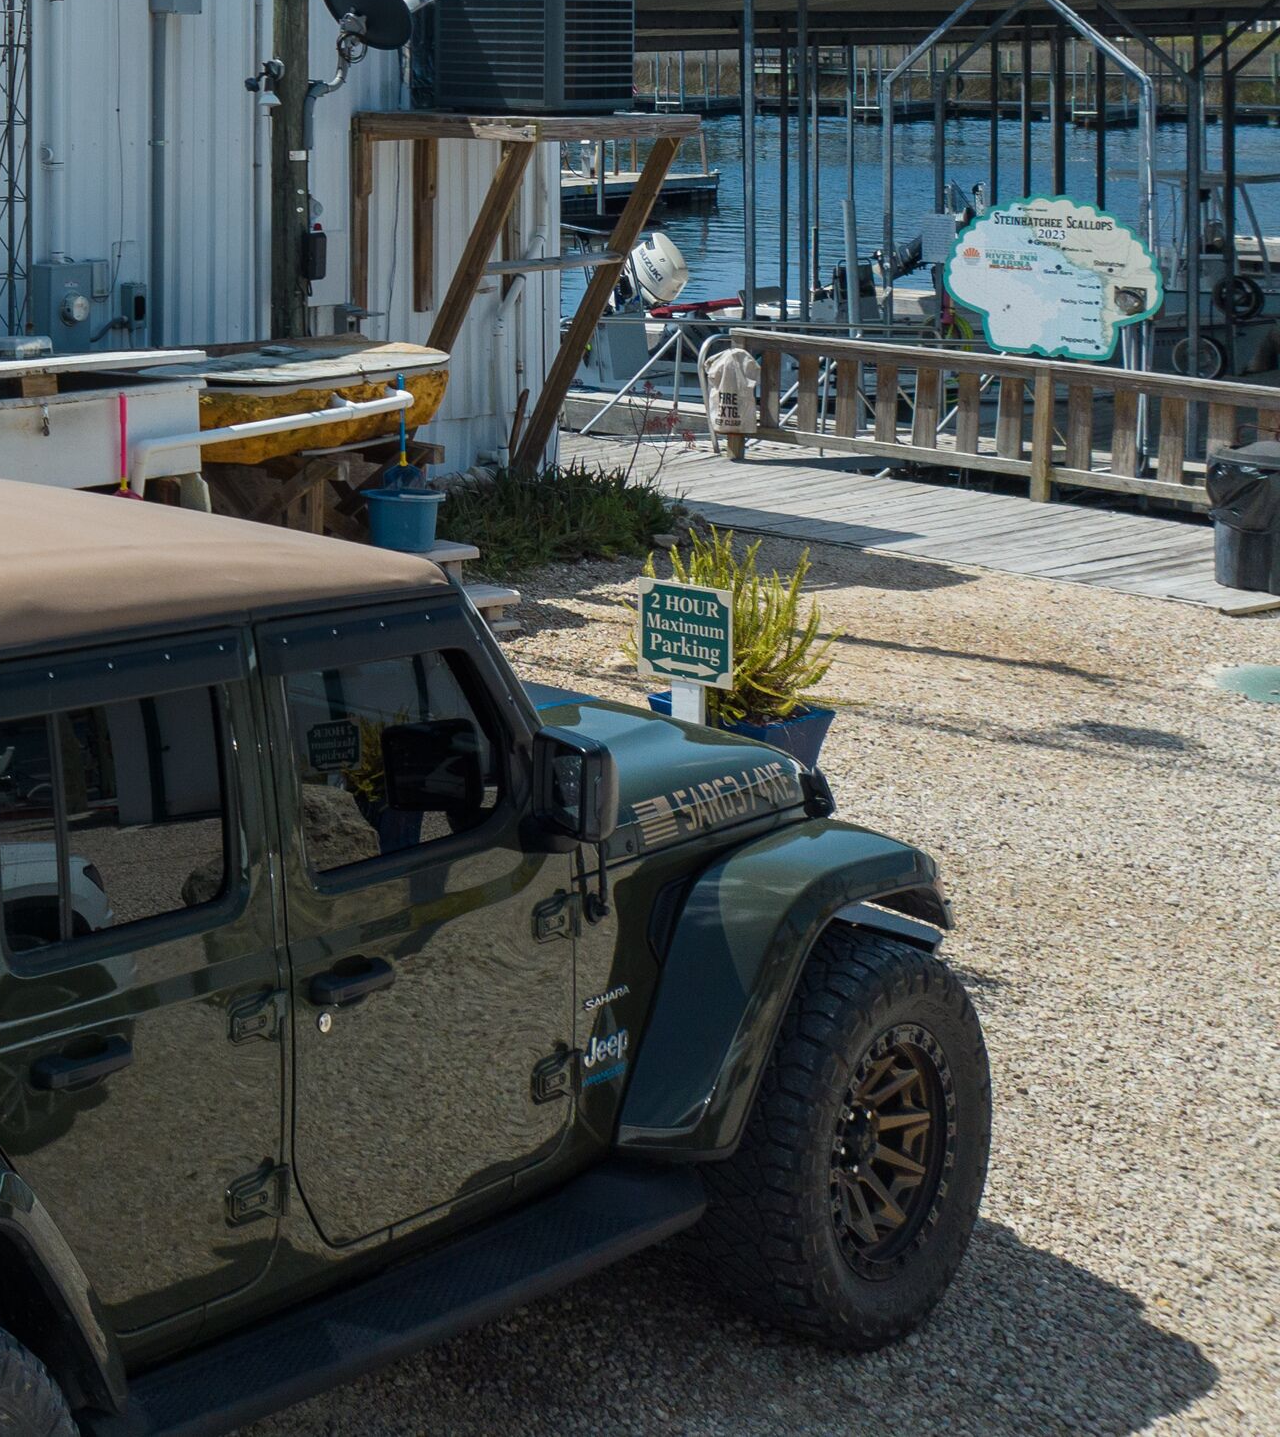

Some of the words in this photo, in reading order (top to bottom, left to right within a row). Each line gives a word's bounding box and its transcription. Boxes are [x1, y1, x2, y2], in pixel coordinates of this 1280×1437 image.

[994, 212, 1063, 229] STEINHATCHEE
[1066, 216, 1114, 231] SCALLOPS
[1038, 229, 1067, 240] 2023
[639, 248, 664, 282] SUZUKI
[1020, 254, 1038, 262] INN
[719, 392, 738, 405] FIRE
[650, 592, 661, 609] 2
[665, 594, 720, 619] HOUR
[646, 611, 725, 640] Maximum
[649, 632, 721, 667] Parking
[585, 984, 631, 1012] SAHARA
[583, 1029, 629, 1068] Jeep
